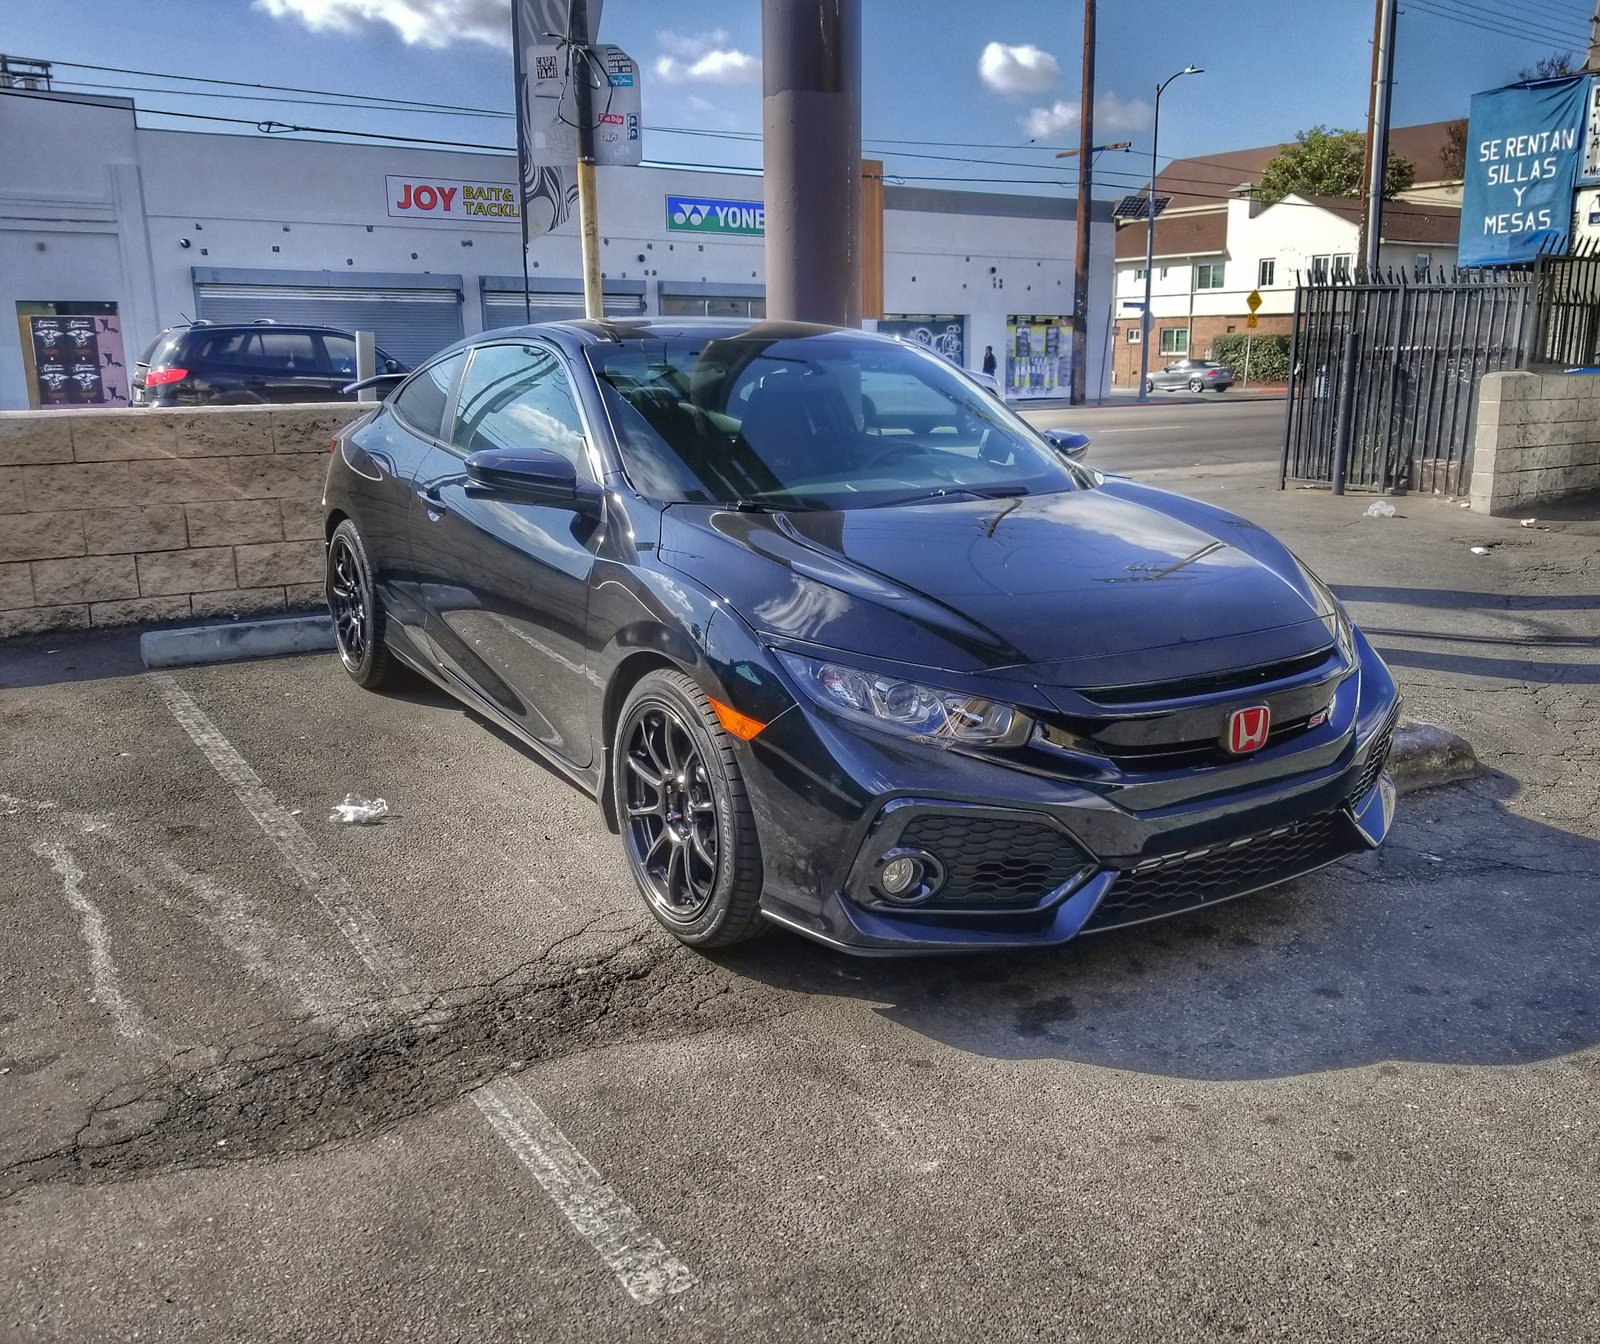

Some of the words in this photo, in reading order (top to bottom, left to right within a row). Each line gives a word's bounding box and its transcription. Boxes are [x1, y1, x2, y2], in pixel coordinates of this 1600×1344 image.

[1479, 139, 1502, 162] SE
[1505, 128, 1575, 159] RENTAN
[1487, 157, 1557, 186] SILLAS
[396, 184, 457, 212] JOY
[462, 185, 514, 202] BAIT&
[1513, 186, 1527, 208] Y
[463, 201, 520, 218] TACKL
[1484, 209, 1551, 236] MESAS
